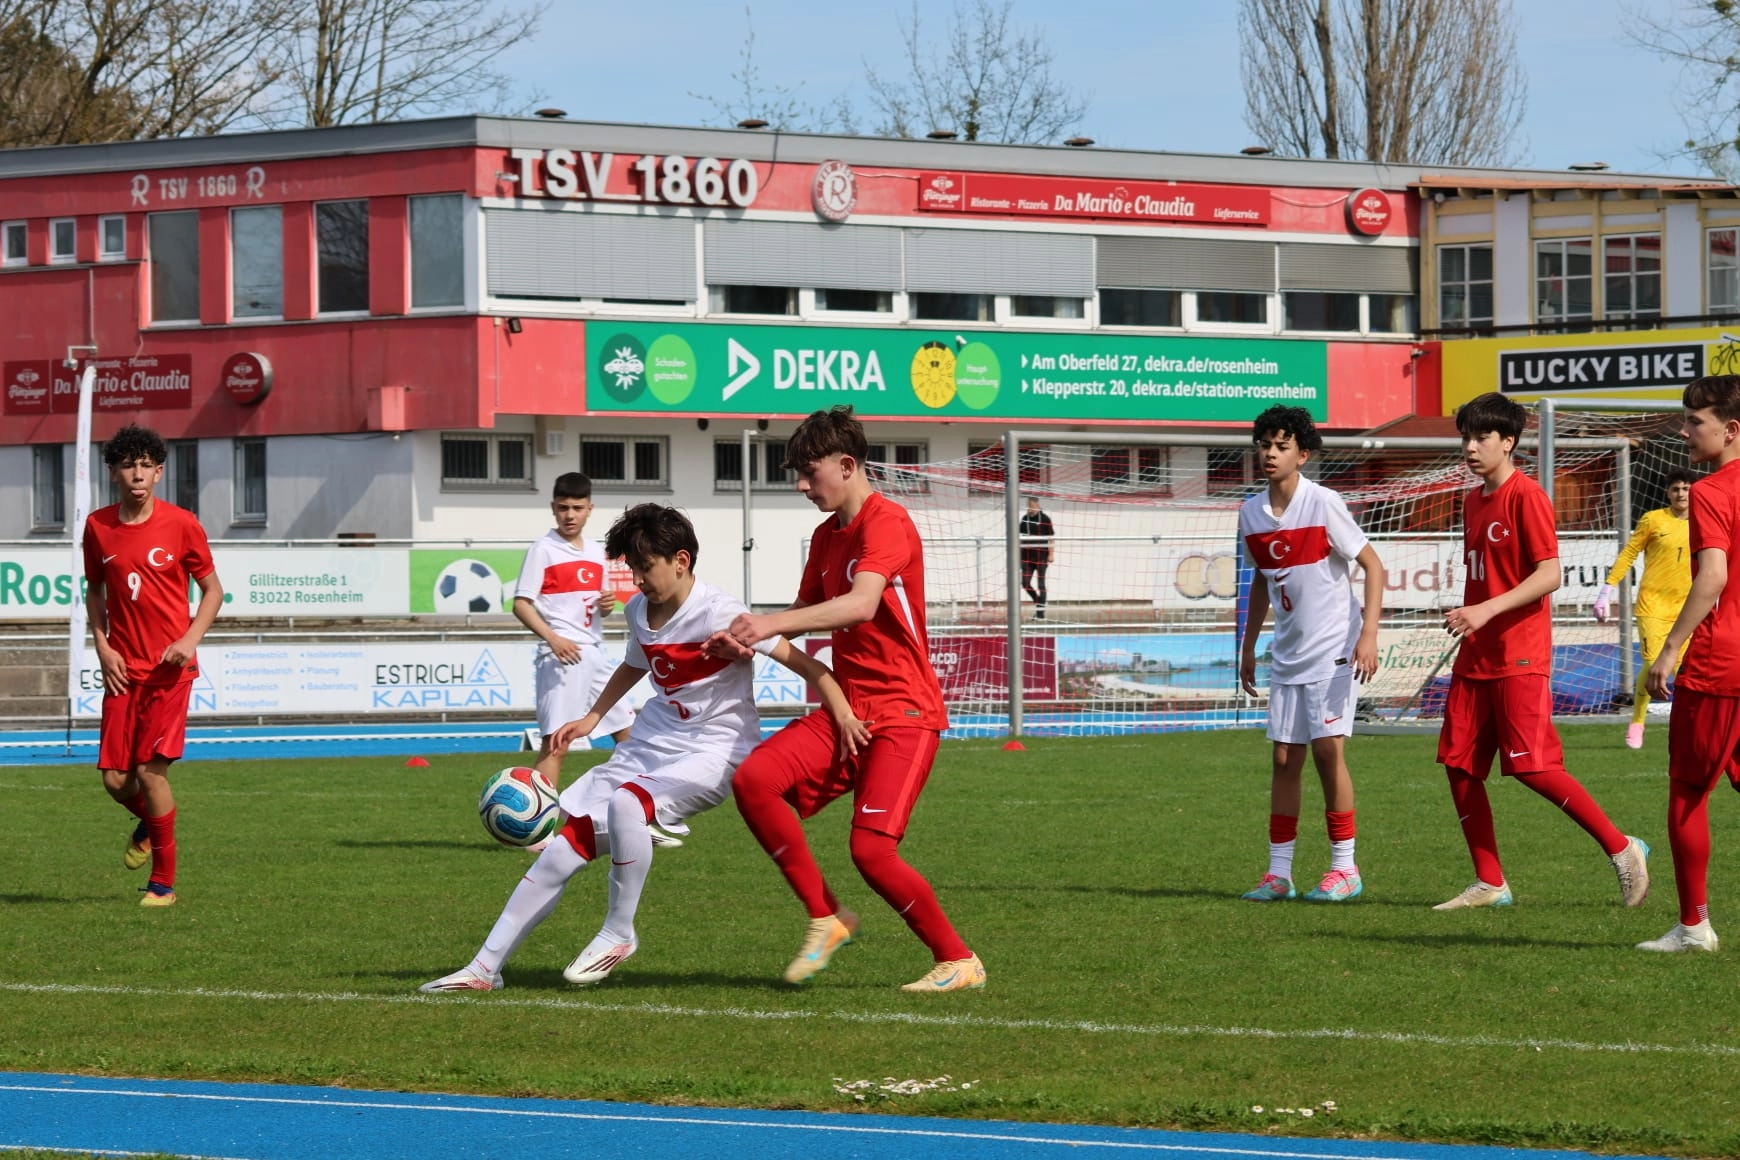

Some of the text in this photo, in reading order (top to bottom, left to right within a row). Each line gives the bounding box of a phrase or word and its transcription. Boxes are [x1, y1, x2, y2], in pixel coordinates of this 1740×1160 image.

[159, 178, 188, 200] TSV
[197, 175, 237, 198] 1860
[511, 148, 758, 207] TSV 1860
[970, 197, 1010, 209] Ristorante
[1017, 199, 1049, 210] Pizzeria
[1054, 195, 1072, 211] Da
[1075, 192, 1122, 214] Mario
[1124, 202, 1132, 214] e
[1134, 194, 1195, 217] Claudia
[1213, 208, 1259, 219] Lieferservice
[773, 349, 887, 391] DEKRA
[1032, 353, 1278, 375] Am Oberfeld 27, dekra.de/rosenheim
[1507, 352, 1695, 385] LUCKY BIKE
[54, 379, 71, 394] Da
[120, 379, 127, 391] e
[130, 369, 190, 391] Claudia
[1032, 378, 1316, 399] Klepperstr. 20, dekra.de/station-rosenheim
[1467, 549, 1485, 581] 16
[127, 572, 141, 601] 9
[249, 573, 347, 586] Gillitzerstraße 1
[249, 590, 363, 604] 83022 Rosenheim
[1281, 584, 1293, 612] 6
[584, 605, 593, 628] 5
[376, 664, 464, 684] ESTRICH
[373, 689, 511, 707] KAPLAN
